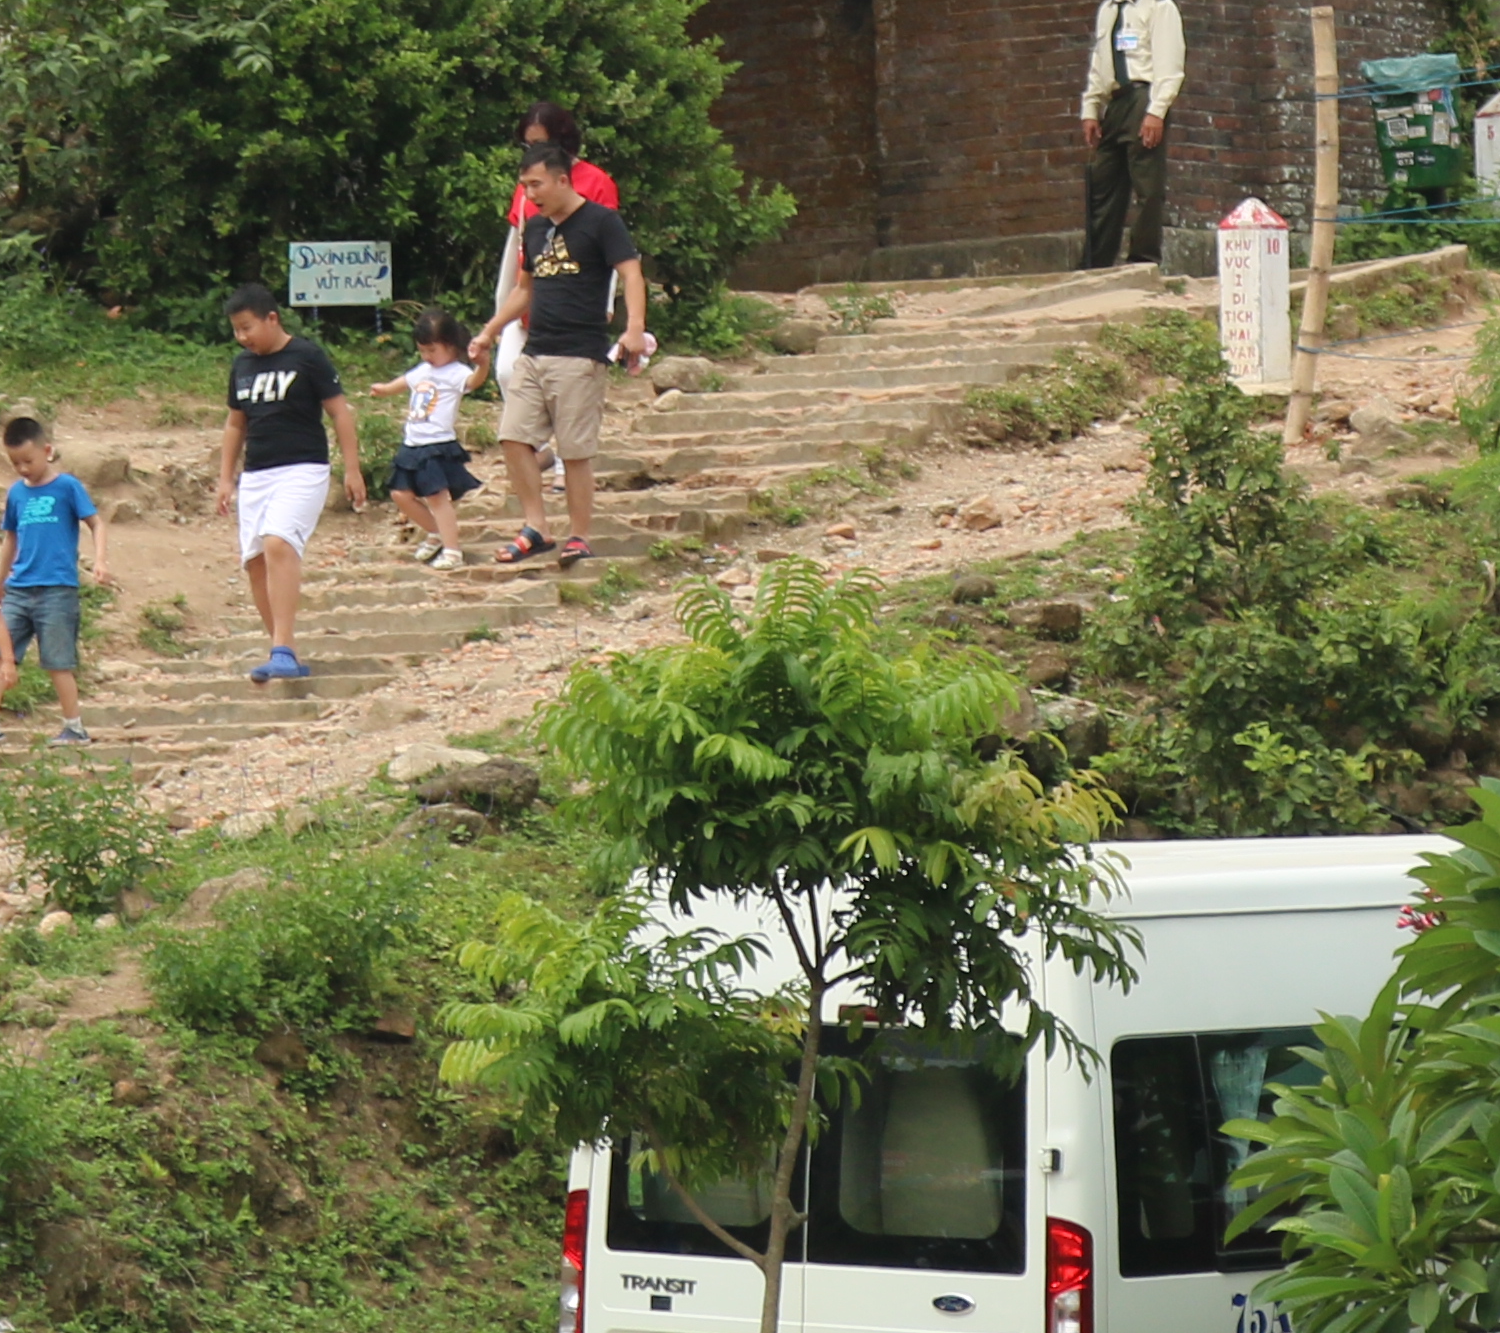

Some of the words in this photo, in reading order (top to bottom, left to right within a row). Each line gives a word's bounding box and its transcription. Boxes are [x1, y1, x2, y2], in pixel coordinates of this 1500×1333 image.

[1486, 123, 1496, 141] 5
[1225, 239, 1252, 252] KHU
[1266, 237, 1281, 255] 10
[1232, 293, 1246, 305] DI
[250, 370, 298, 404] FLY
[619, 1273, 698, 1295] TRANSIT
